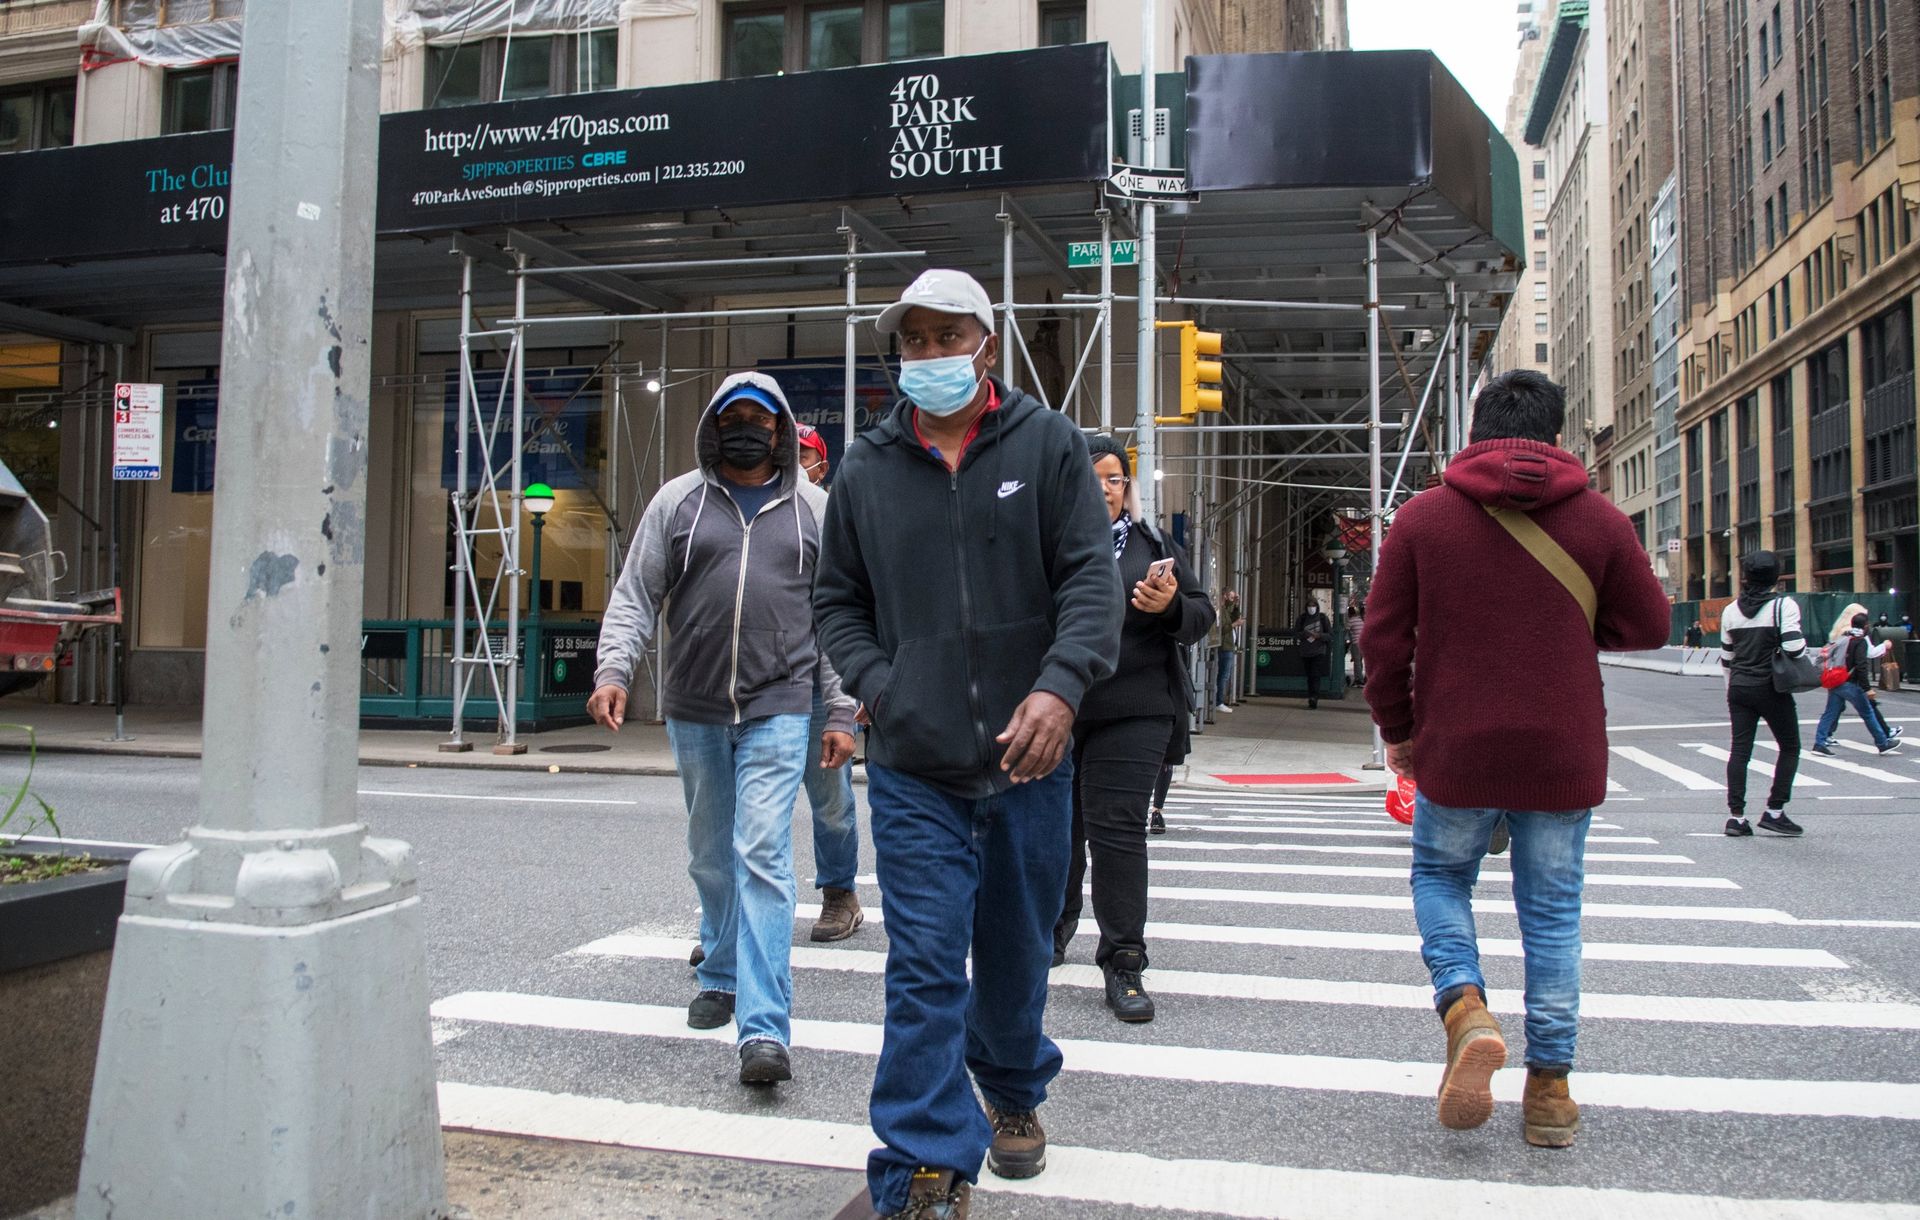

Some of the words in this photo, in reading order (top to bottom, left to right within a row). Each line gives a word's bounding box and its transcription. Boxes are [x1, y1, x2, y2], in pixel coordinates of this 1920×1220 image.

[890, 74, 940, 102] 470
[889, 96, 978, 128] PARK
[424, 113, 671, 157] http://www.470pas.com
[889, 124, 954, 154] AVE
[582, 150, 628, 167] CBRE
[890, 145, 1004, 179] SOUTH
[145, 168, 186, 193] The
[191, 163, 232, 189] Clu
[412, 170, 651, 206] 470ParkAveSouth@Sjpproperties.com
[662, 160, 746, 180] 212.335.2200
[1119, 175, 1144, 190] ONE
[1157, 179, 1185, 192] WAY
[160, 203, 181, 224] at
[185, 195, 225, 221] 470
[1114, 241, 1132, 255] AV
[120, 411, 127, 423] 3
[115, 469, 149, 478] 107007
[1001, 480, 1019, 491] NIKE
[1308, 572, 1332, 584] DEL
[554, 638, 565, 649] 33
[565, 638, 574, 649] St
[575, 638, 597, 649] Station
[1268, 637, 1295, 646] Street
